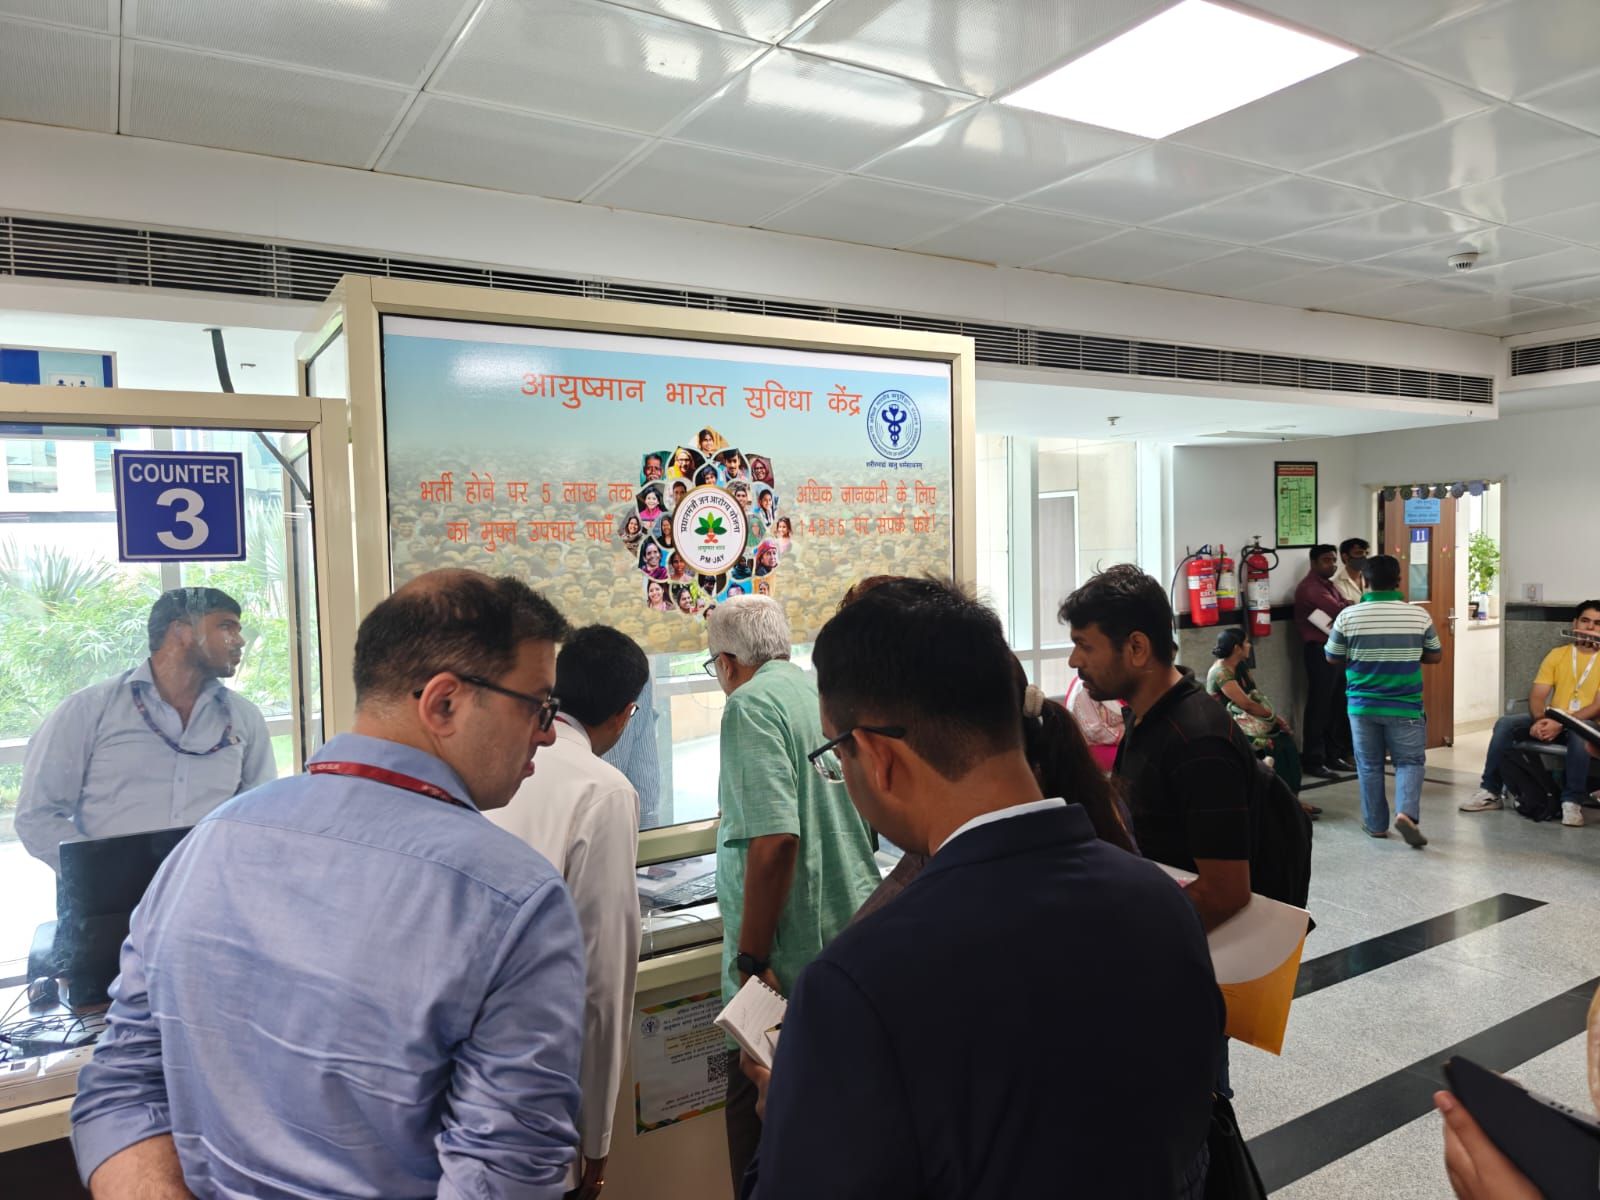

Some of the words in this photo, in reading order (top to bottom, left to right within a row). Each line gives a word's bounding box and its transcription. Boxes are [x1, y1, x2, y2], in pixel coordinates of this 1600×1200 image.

[521, 373, 646, 409] आयुष्मान
[666, 382, 727, 406] भारत
[743, 379, 813, 418] सुविधा
[826, 384, 863, 416] केंद्र
[128, 463, 231, 484] COUNTER
[421, 472, 454, 503] भर्ती
[464, 472, 495, 504] होने
[507, 481, 529, 504] पर
[541, 483, 551, 504] 5
[562, 482, 598, 504] लाख
[608, 483, 634, 503] तक
[796, 479, 833, 504] अधिक
[840, 480, 889, 504] जानकारी
[896, 480, 908, 503] के
[914, 480, 937, 504] लिए
[156, 488, 209, 550] 3
[446, 521, 469, 544] का
[528, 521, 577, 543] उपचार
